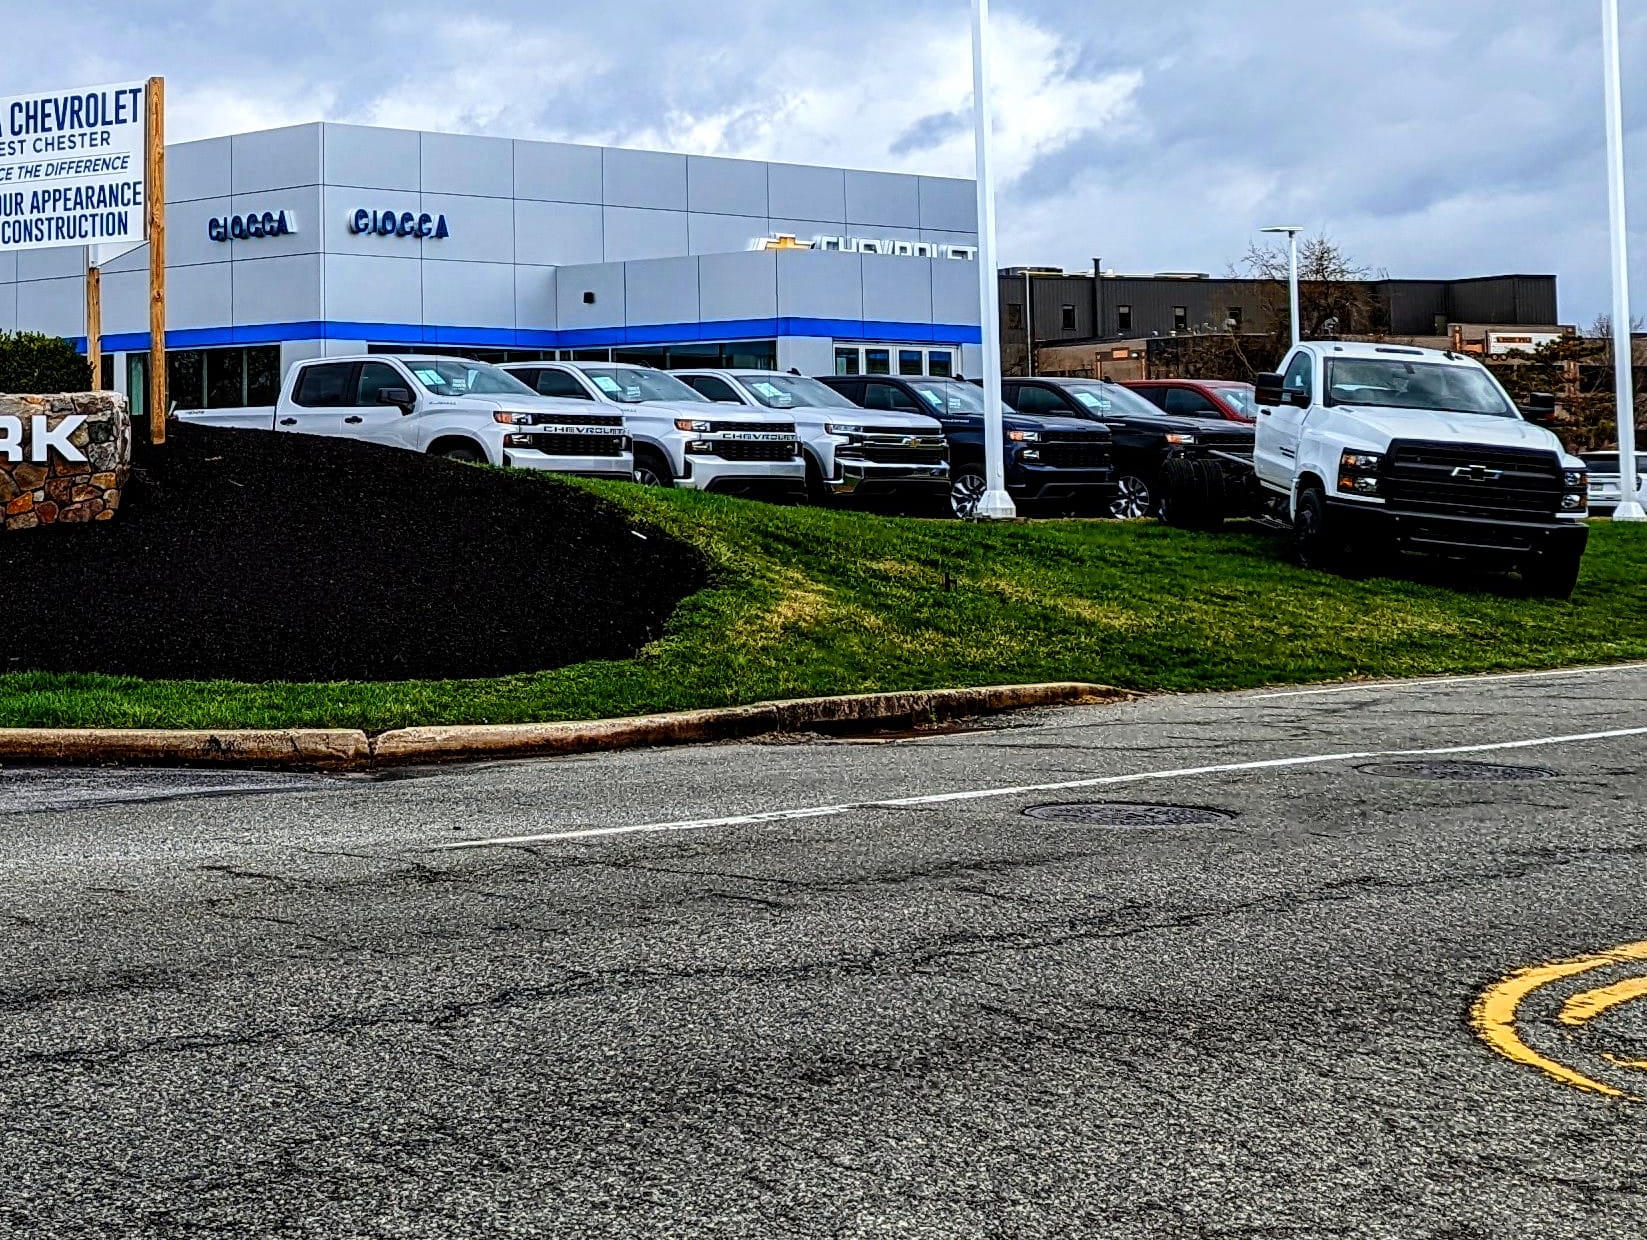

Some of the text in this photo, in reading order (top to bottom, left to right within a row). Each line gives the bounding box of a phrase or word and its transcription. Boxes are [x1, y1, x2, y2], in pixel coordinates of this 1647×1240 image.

[10, 87, 143, 137] CHEVROLET
[32, 130, 111, 154] CHESTER
[17, 162, 42, 180] THE
[44, 155, 131, 177] DIFFERENCE
[30, 181, 143, 214] APPEARANCE
[1, 211, 129, 245] CONSTRUCTION
[208, 210, 296, 242] CIOCCA
[349, 207, 449, 239] CIOCCA
